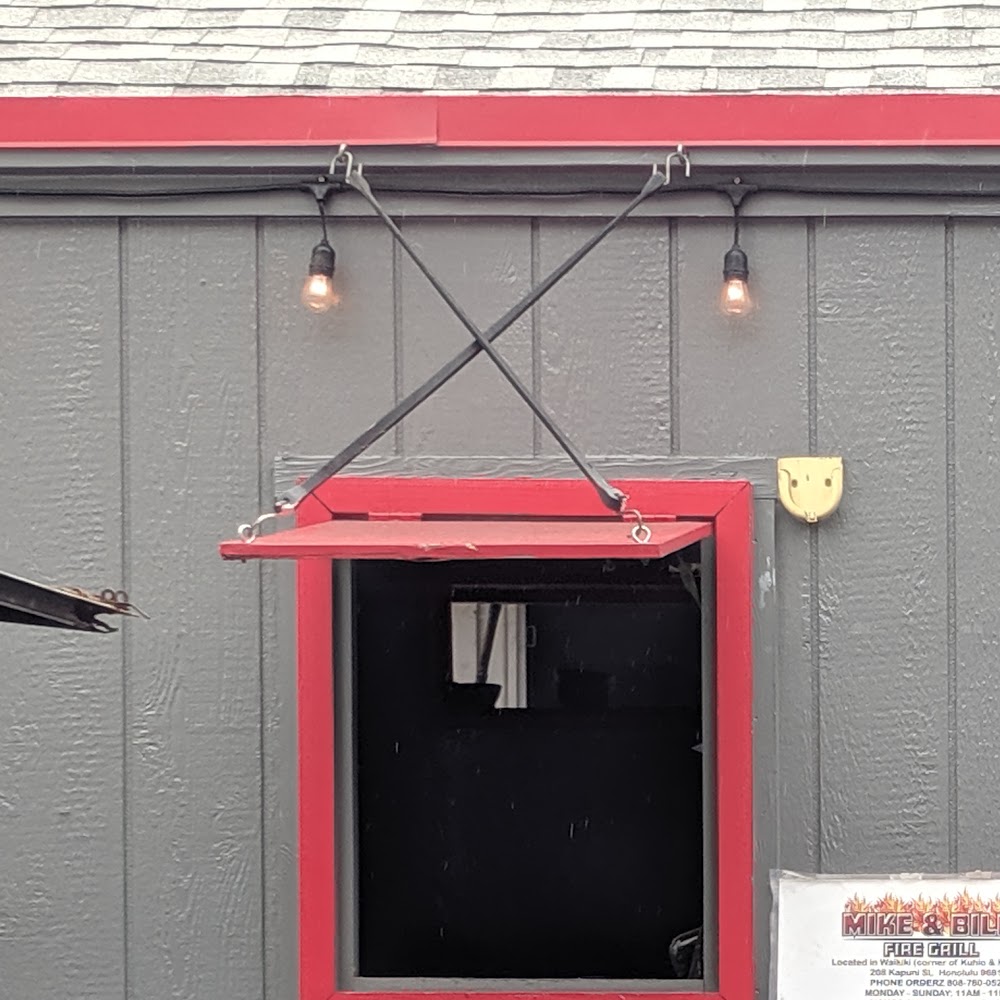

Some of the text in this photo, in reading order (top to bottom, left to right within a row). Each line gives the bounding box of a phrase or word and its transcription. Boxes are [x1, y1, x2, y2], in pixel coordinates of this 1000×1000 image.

[842, 912, 914, 937] MIKE
[922, 912, 944, 937] &
[883, 942, 980, 958] FIRE GRILL
[865, 989, 905, 997] MONDAY
[956, 989, 981, 997] 11AM
